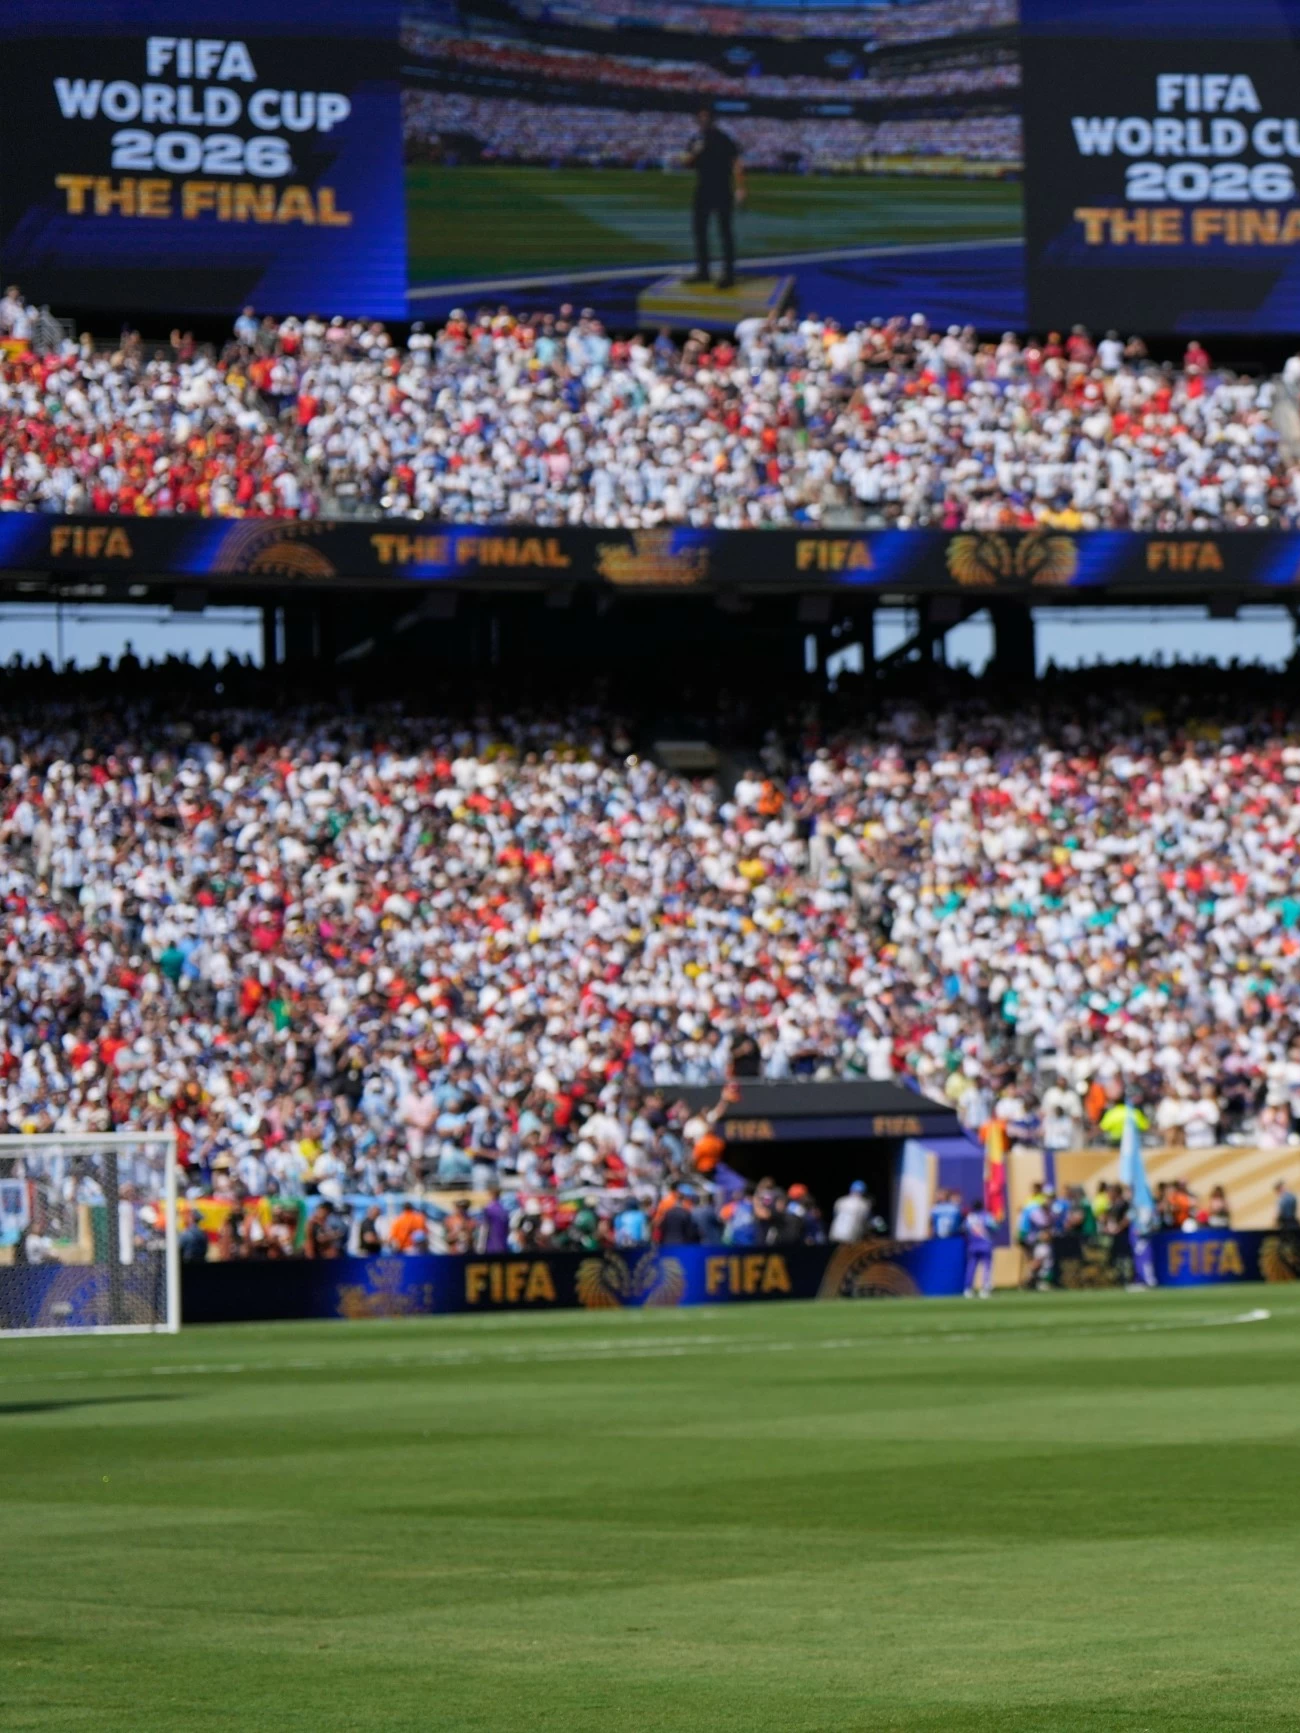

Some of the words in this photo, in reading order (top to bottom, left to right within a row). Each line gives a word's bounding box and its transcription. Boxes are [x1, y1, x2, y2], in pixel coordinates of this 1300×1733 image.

[147, 37, 256, 82] FIFA
[54, 78, 241, 126] WORLD
[248, 90, 350, 131] CUP
[1156, 74, 1260, 112] FIFA
[111, 129, 292, 177] 2026
[1072, 117, 1248, 157] WORLD
[55, 175, 172, 218] THE
[182, 181, 352, 226] FINAL
[1125, 163, 1294, 201] 2026
[1074, 208, 1183, 245] THE
[50, 526, 133, 559] FIFA
[371, 533, 448, 565] THE
[456, 535, 570, 568] FINAL
[798, 540, 874, 571] FIFA
[1147, 541, 1224, 572] FIFA
[725, 1119, 775, 1140] FIFA
[875, 1116, 923, 1137] FIFA
[705, 1255, 792, 1294] FIFA
[1168, 1240, 1244, 1276] FIFA
[465, 1262, 556, 1303] FIFA
